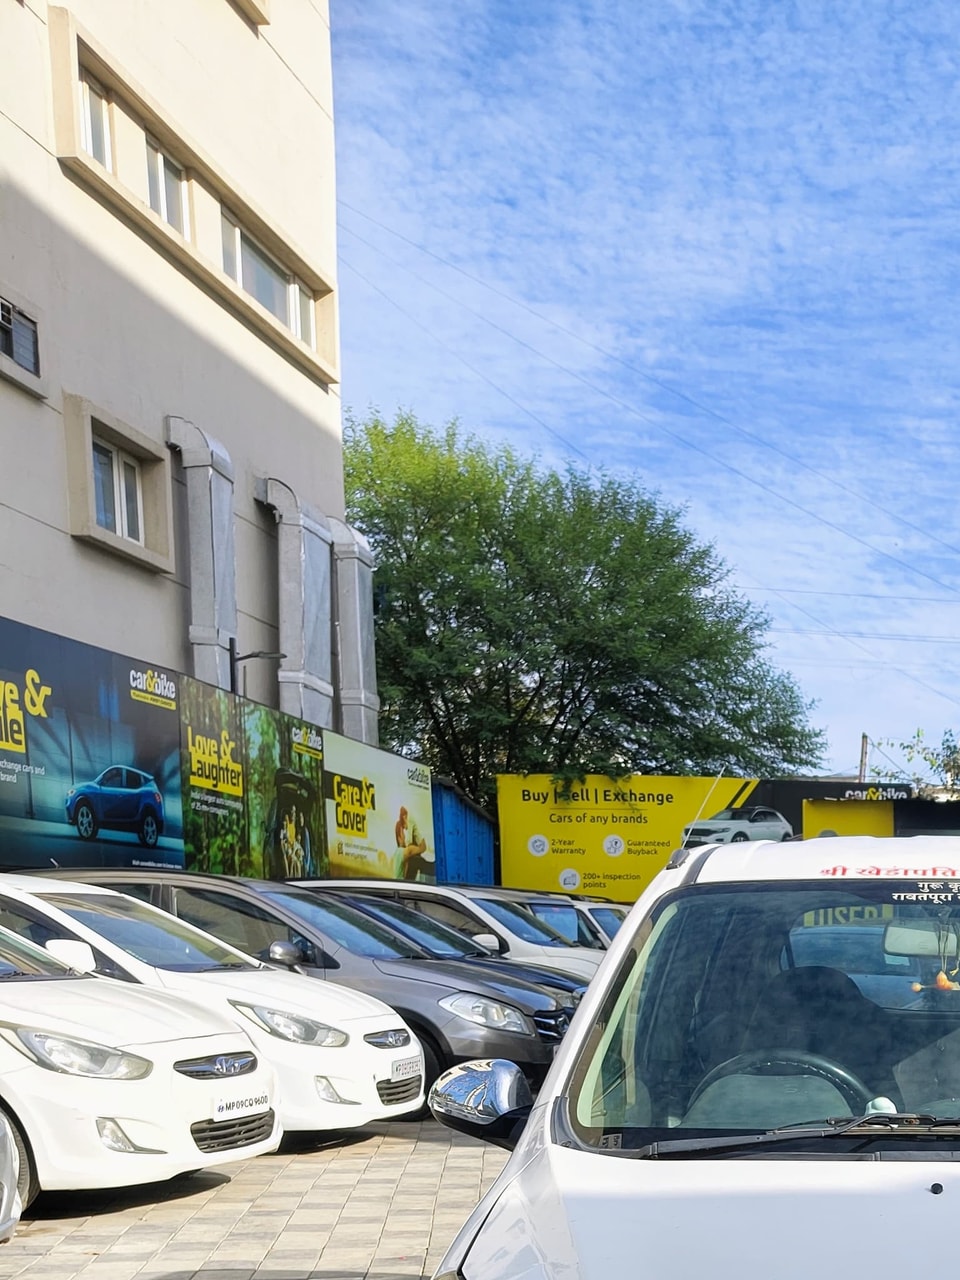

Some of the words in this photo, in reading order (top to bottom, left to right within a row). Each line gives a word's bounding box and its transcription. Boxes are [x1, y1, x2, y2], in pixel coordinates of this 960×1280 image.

[130, 669, 176, 699] car&bike
[187, 726, 218, 757] Love
[190, 753, 242, 788] Laughter
[333, 775, 360, 806] Care
[522, 789, 549, 804] Buy
[603, 789, 674, 805] Exchange
[336, 802, 366, 833] Cover
[549, 814, 573, 823] Cars
[576, 813, 587, 823] of
[590, 815, 608, 826] any
[611, 813, 648, 823] brands
[551, 848, 586, 856] Warranty
[627, 848, 658, 857] Buyback
[583, 881, 607, 889] points
